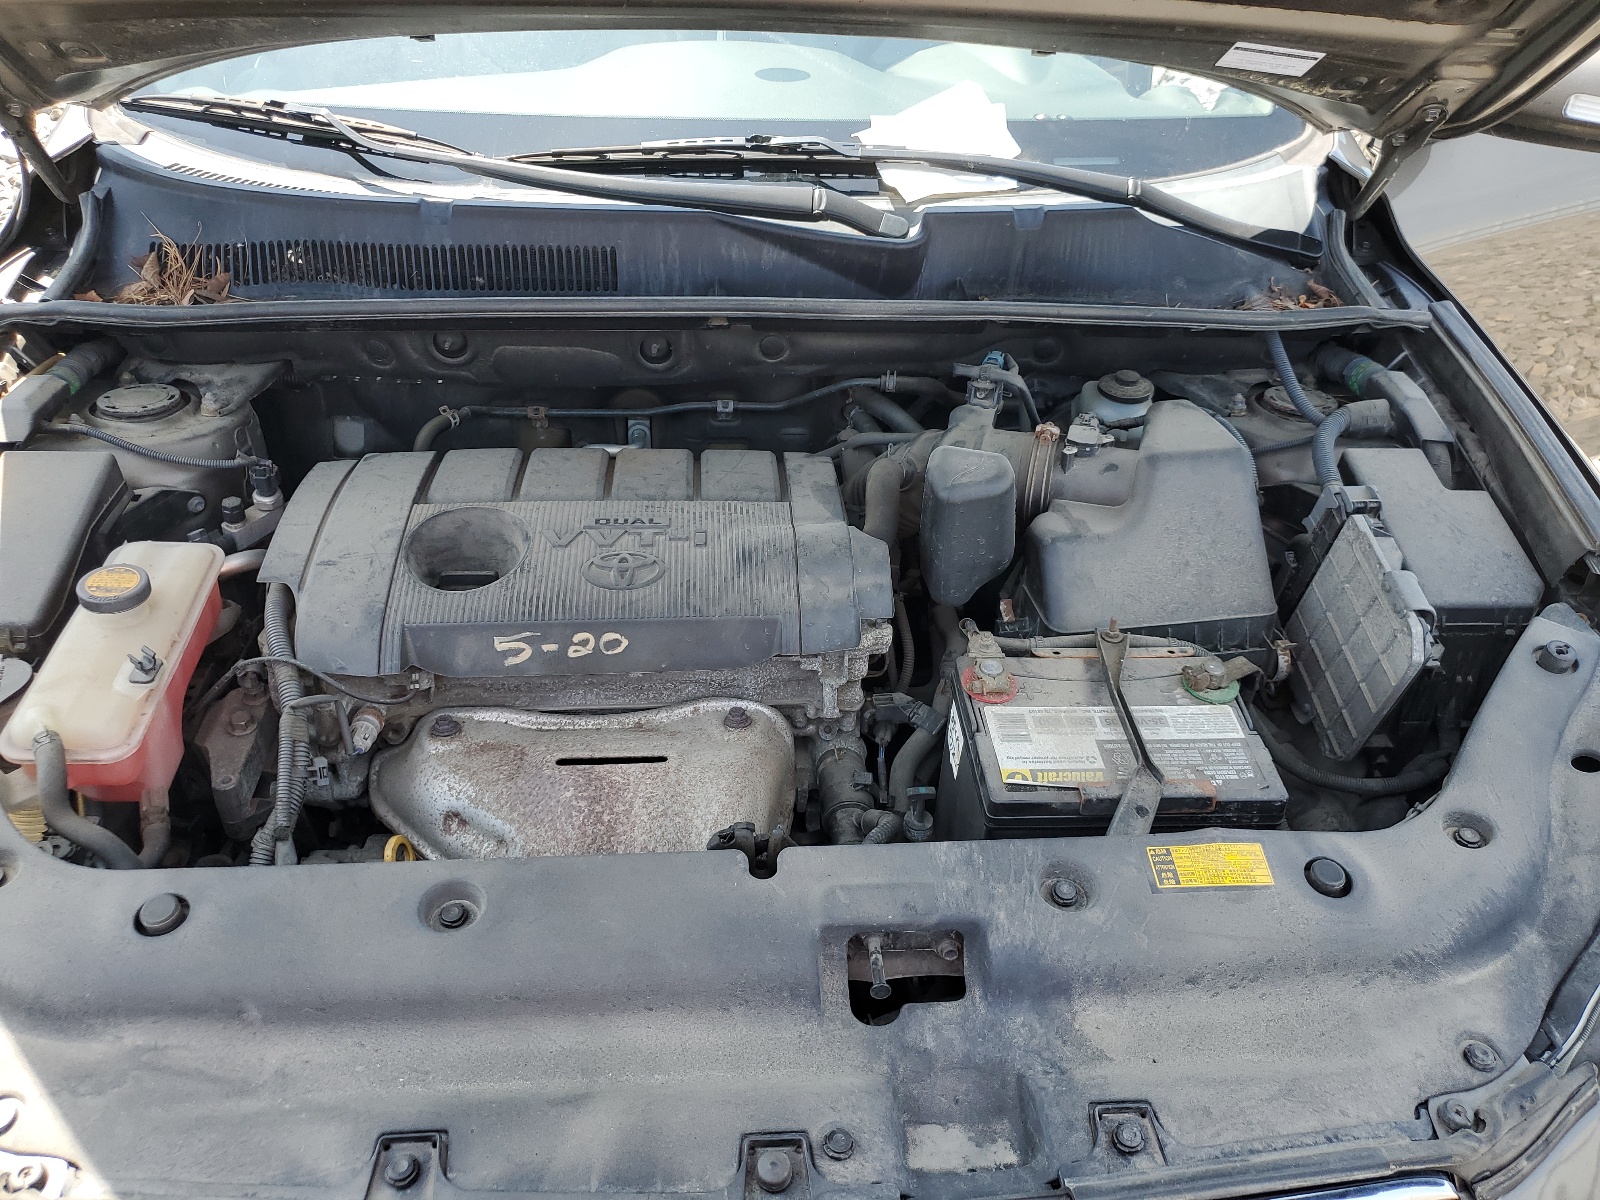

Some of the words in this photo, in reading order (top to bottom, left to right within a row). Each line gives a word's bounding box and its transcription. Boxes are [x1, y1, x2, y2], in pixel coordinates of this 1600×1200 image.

[594, 517, 662, 526] DUAL
[493, 631, 629, 667] 5-20
[1036, 772, 1105, 783] Valucraft
